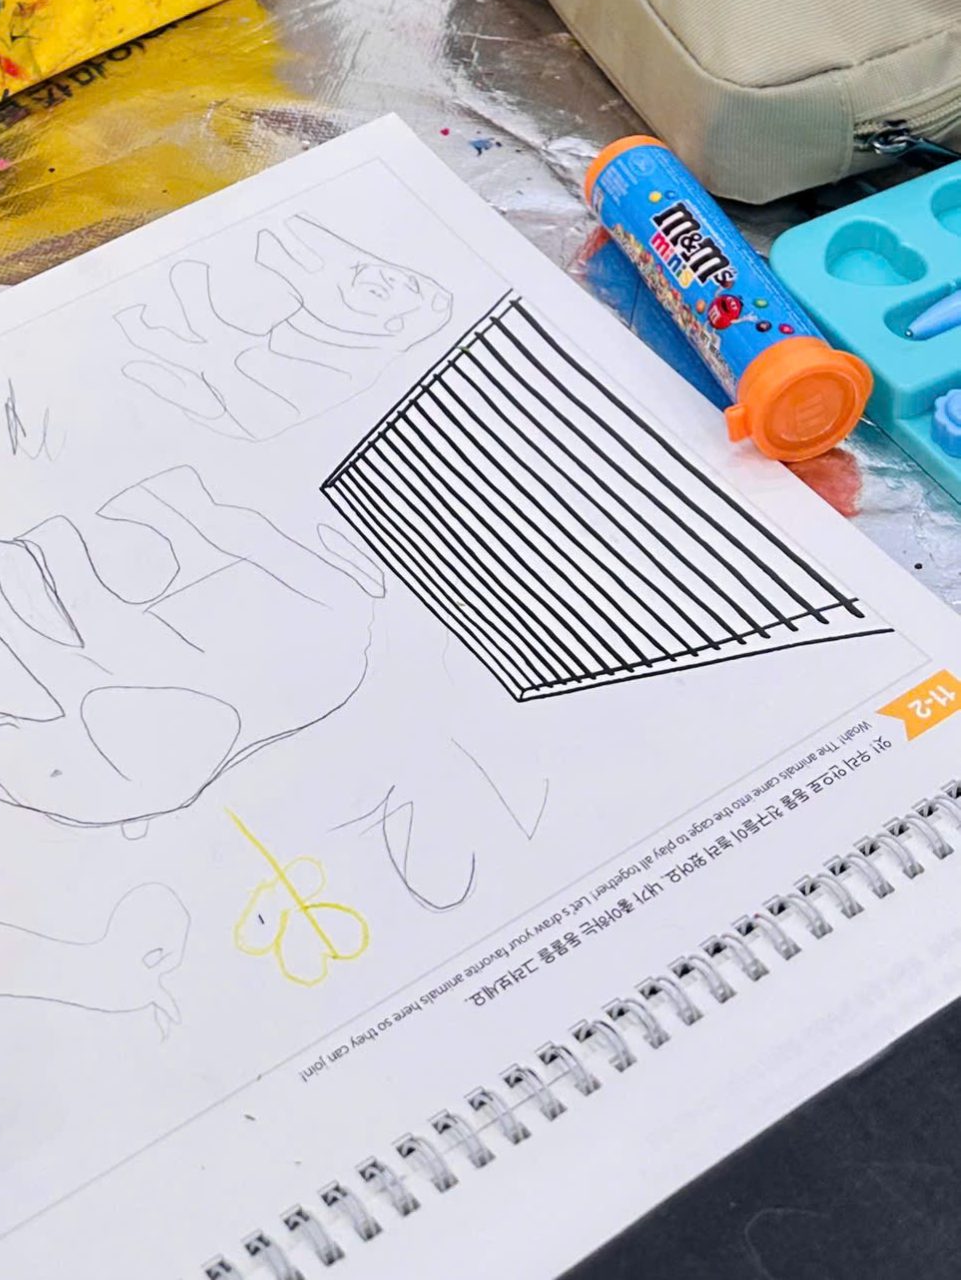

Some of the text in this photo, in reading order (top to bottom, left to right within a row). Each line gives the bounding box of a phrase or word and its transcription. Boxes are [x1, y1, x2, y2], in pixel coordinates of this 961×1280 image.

[650, 233, 694, 286] minis
[908, 683, 956, 718] 11-2
[840, 748, 872, 772] 우리
[868, 734, 893, 754] 앗!
[804, 763, 848, 794] 안으로
[778, 787, 810, 811] 동물
[728, 803, 784, 843] 친구들이
[659, 851, 708, 884] 왔어요.
[298, 719, 873, 1083] Woah! The animals came into the cage to play all together! Let's draw your favorite animals here so they can join!
[631, 881, 664, 905] 내가
[577, 897, 636, 936] 좋아하는
[535, 930, 582, 965] 동물을
[462, 956, 540, 1007] 그려보세요.
